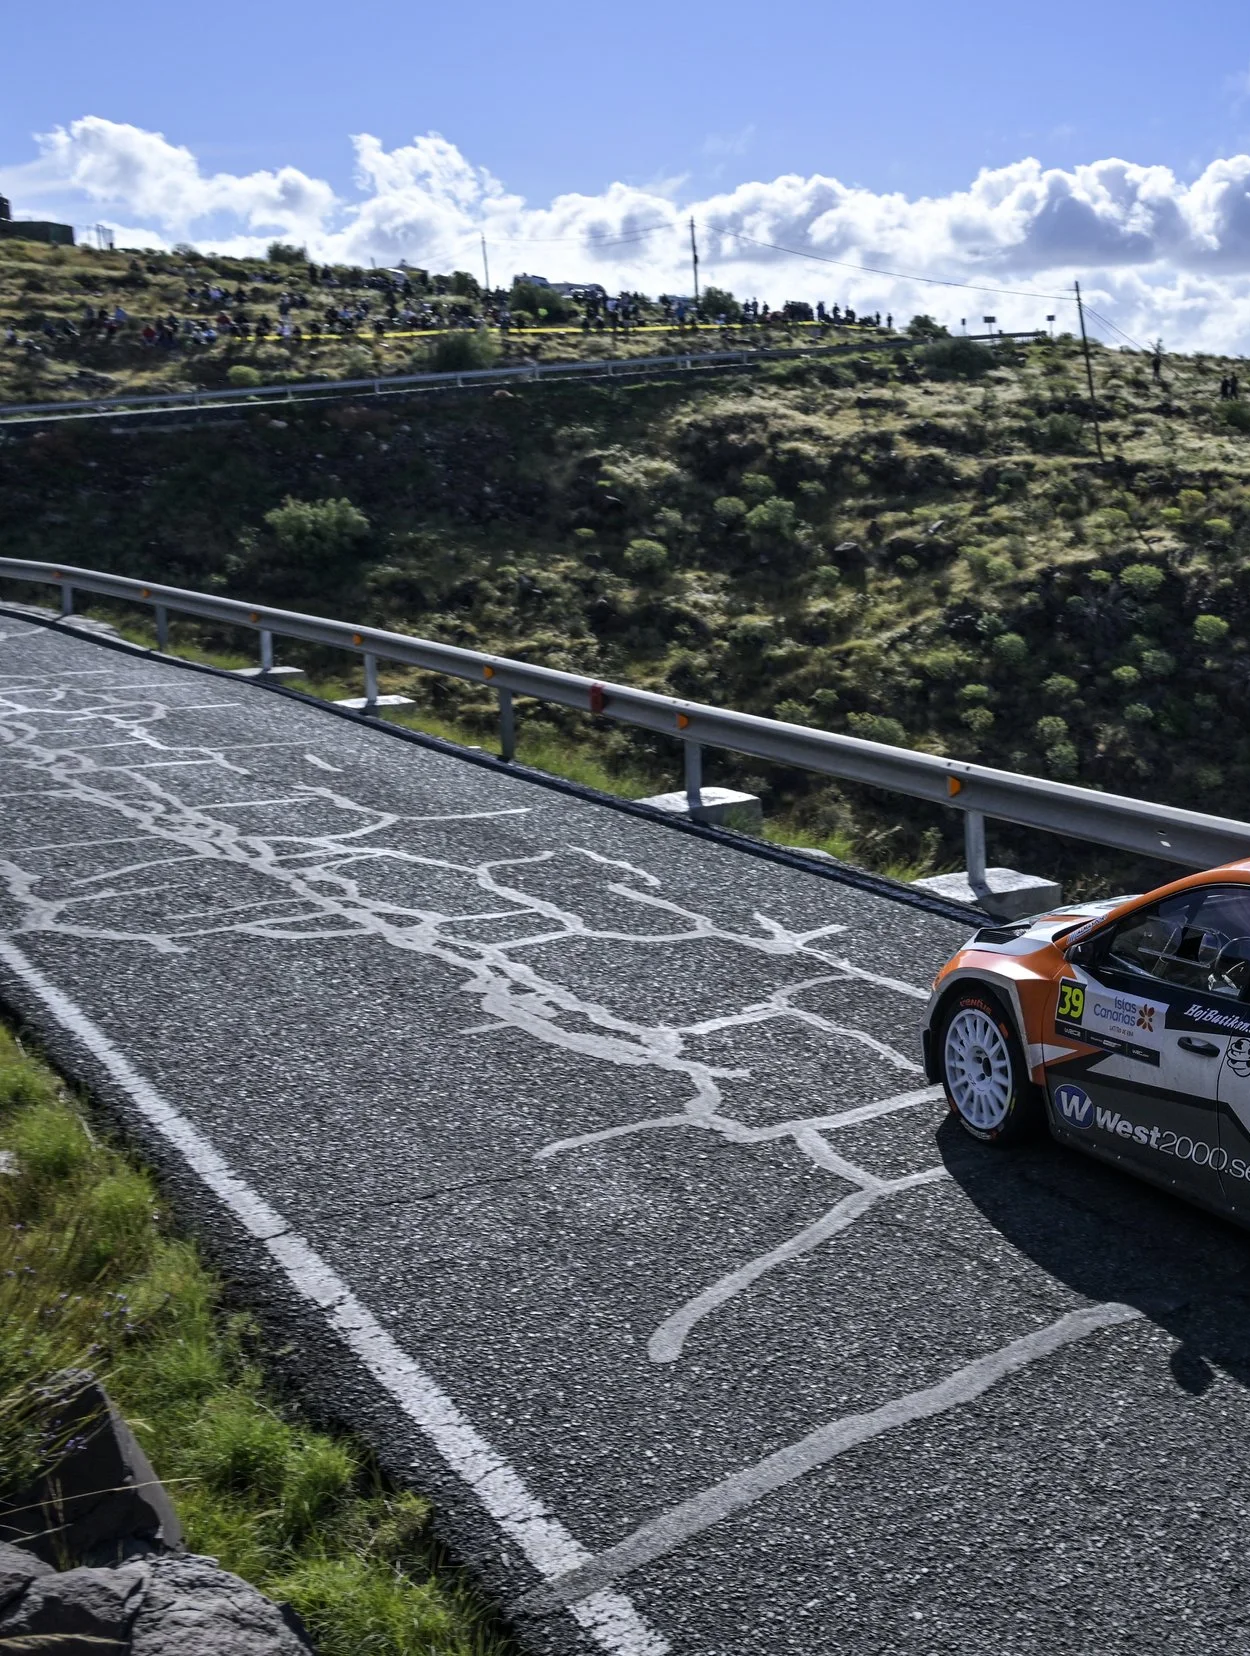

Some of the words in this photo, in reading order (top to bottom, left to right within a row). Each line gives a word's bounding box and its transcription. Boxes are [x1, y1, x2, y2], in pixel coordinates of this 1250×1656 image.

[1058, 985, 1084, 1018] 39
[1115, 996, 1137, 1013] Islas
[1093, 1003, 1136, 1027] Canarias
